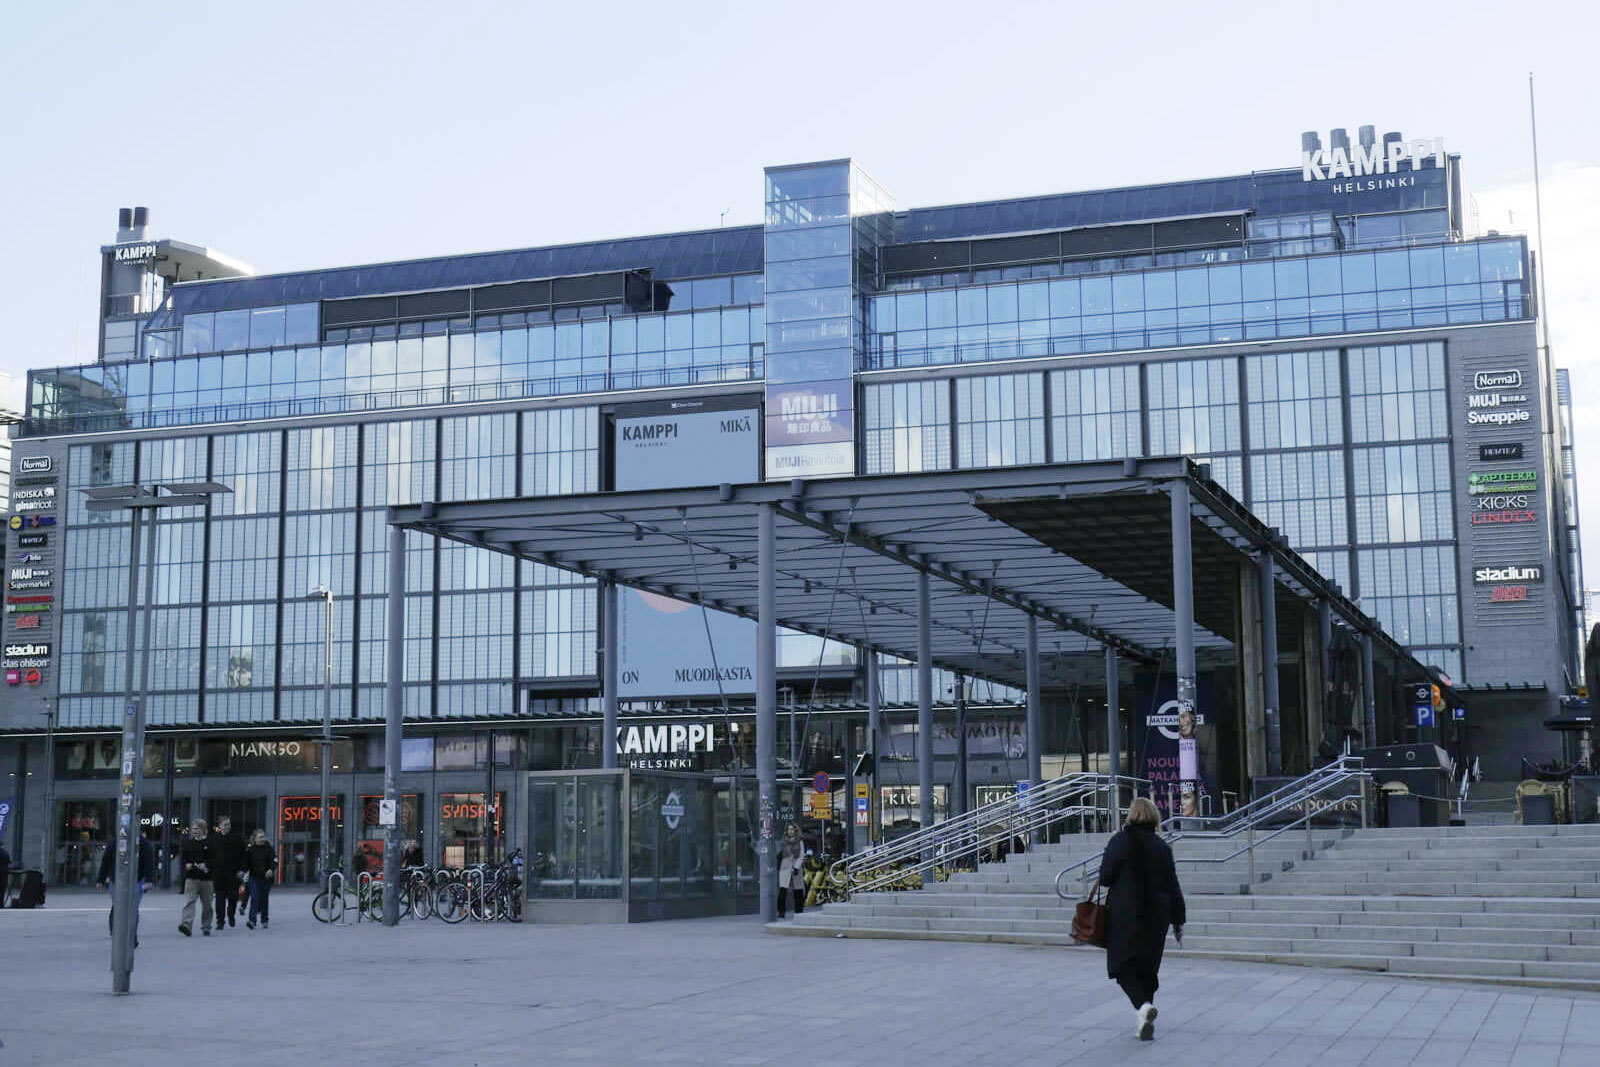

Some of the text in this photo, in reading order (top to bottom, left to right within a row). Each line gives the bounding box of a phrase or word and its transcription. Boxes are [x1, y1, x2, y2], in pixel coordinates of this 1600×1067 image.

[1302, 137, 1446, 182] KAMPPI
[1333, 177, 1415, 194] HELSINKI
[115, 245, 157, 261] KAMPPI
[1479, 373, 1516, 386] Normal
[781, 394, 837, 421] MUJI
[1469, 394, 1500, 408] MUJI
[1468, 409, 1530, 425] Swappie
[622, 415, 752, 441] KAMPPI MIKÄ
[23, 460, 48, 469] Normal
[13, 490, 44, 499] INDISKA
[1478, 495, 1528, 509] KICKS
[1472, 510, 1537, 525] LINDEX
[11, 568, 32, 580] MUJI
[1475, 566, 1540, 582] stadium
[5, 644, 48, 656] stadium
[622, 666, 752, 685] ON MUODIKASTA
[1417, 708, 1430, 726] P
[630, 758, 692, 769] HELSINKI
[856, 811, 868, 824] M
